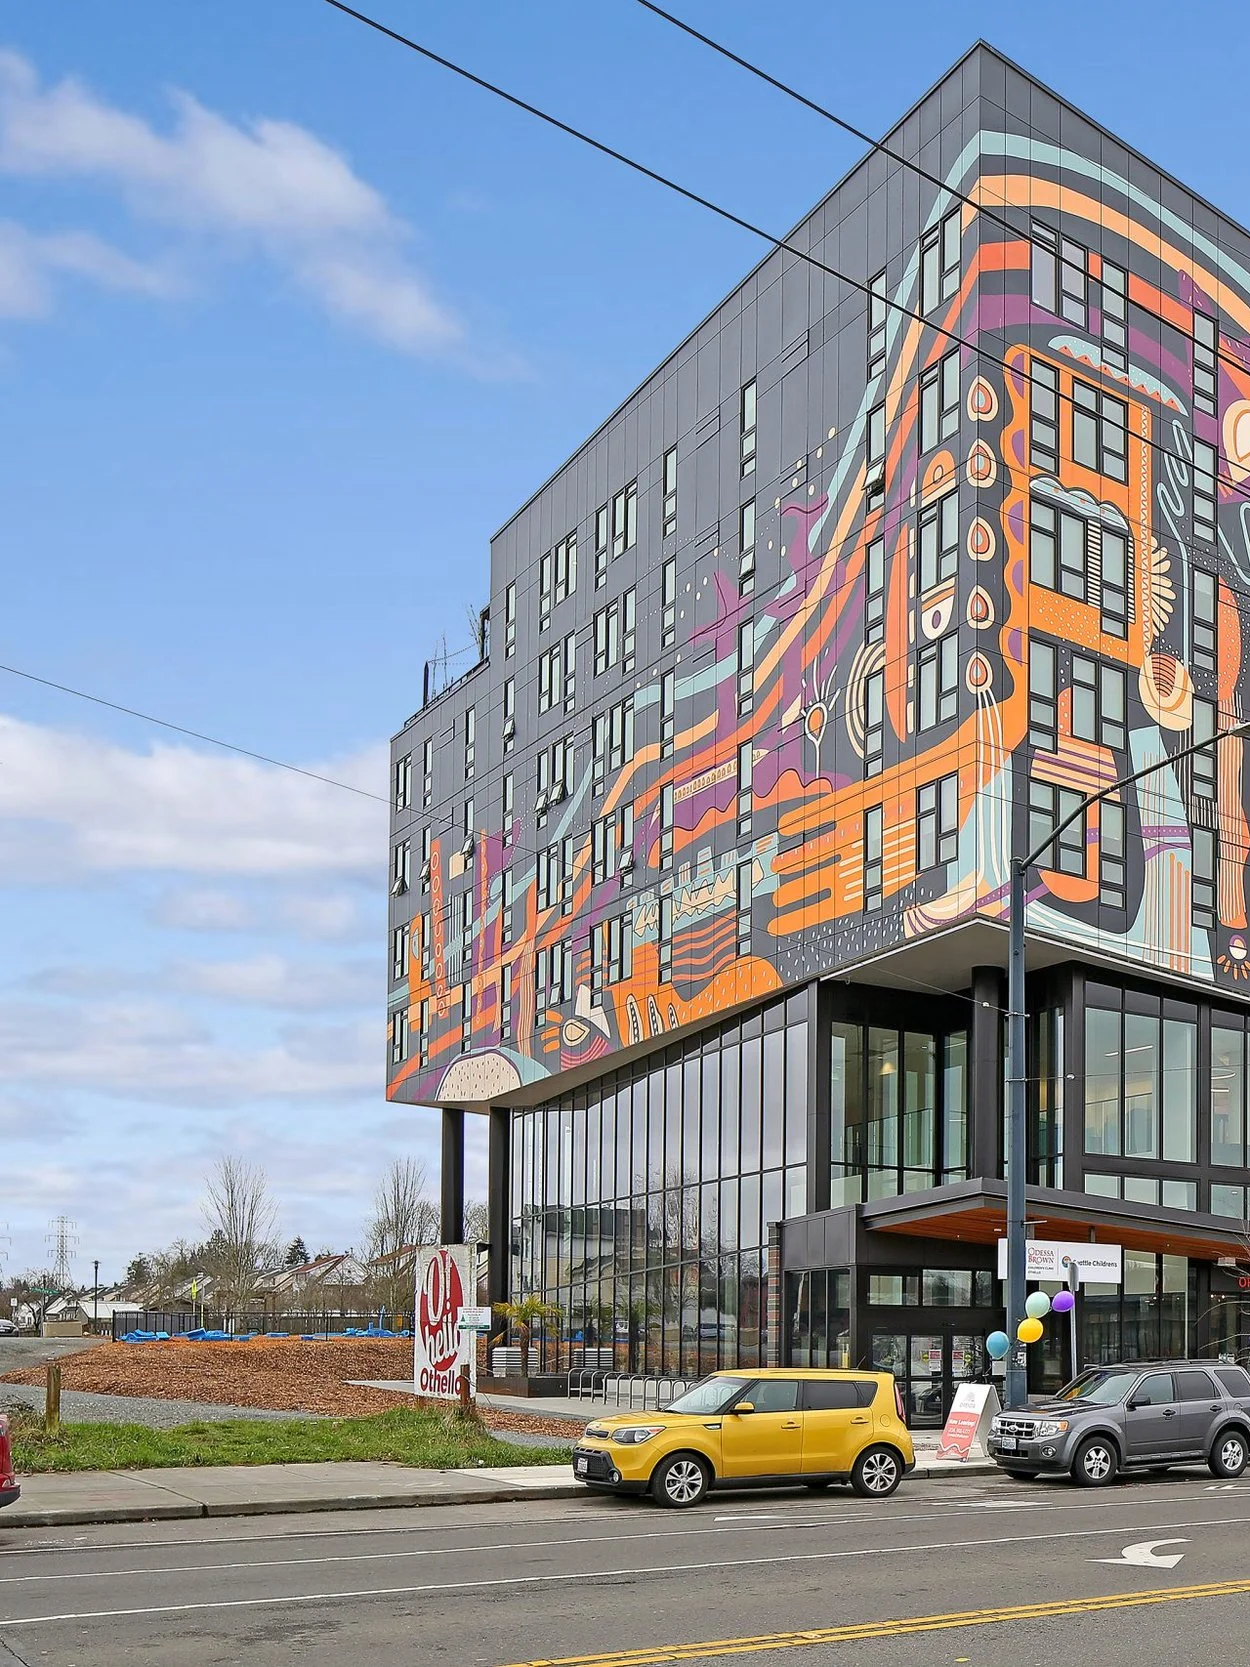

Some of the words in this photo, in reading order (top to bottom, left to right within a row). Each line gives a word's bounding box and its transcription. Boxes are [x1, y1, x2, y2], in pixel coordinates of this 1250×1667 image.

[1028, 1247, 1055, 1256] ODESSA
[1028, 1256, 1055, 1265] BROWN
[1092, 1260, 1117, 1268] Children's
[420, 1367, 462, 1395] Othello
